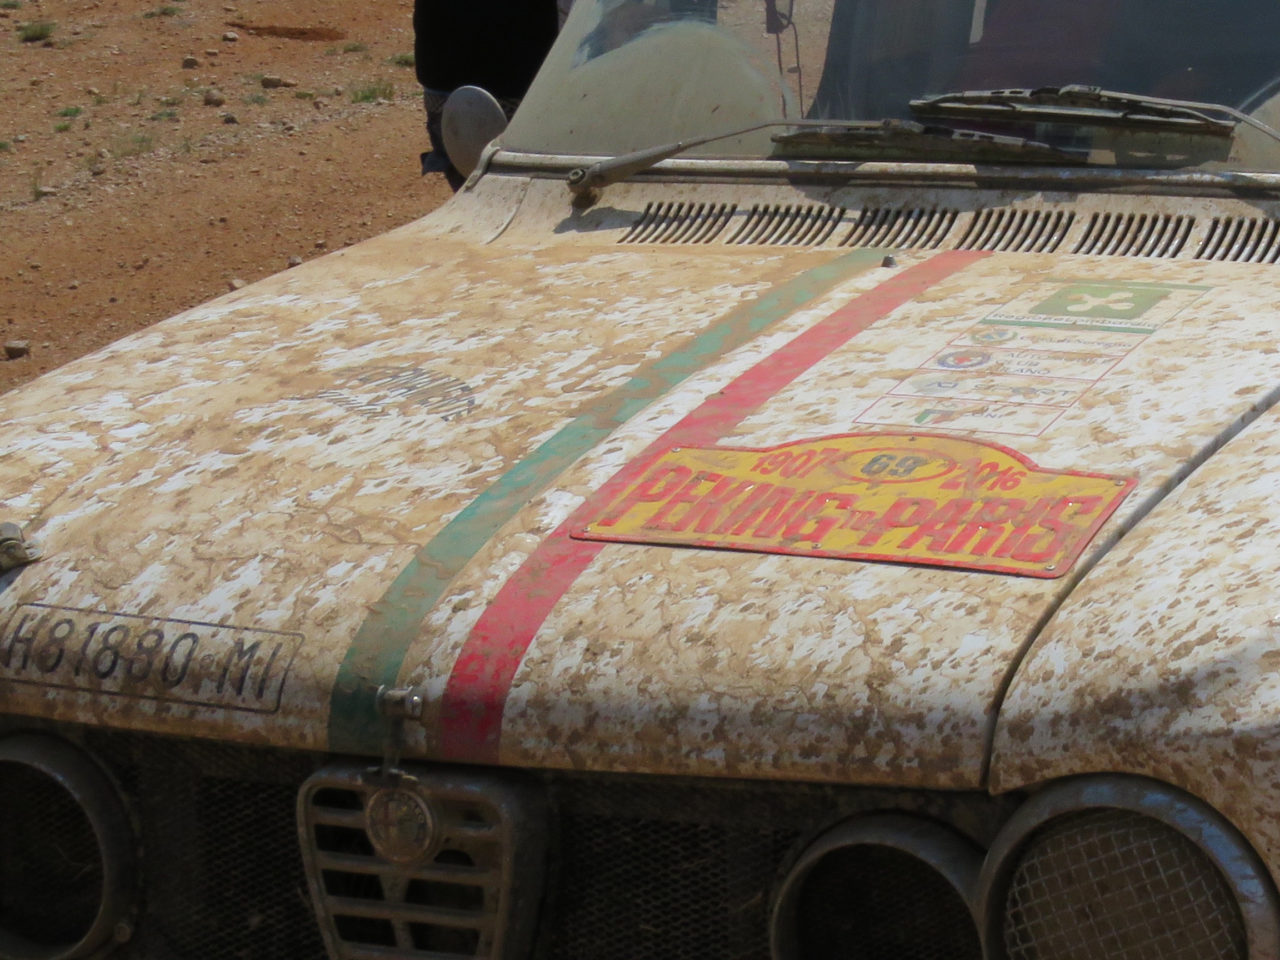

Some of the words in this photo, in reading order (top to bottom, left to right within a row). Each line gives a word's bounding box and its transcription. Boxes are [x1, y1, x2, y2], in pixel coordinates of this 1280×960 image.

[597, 461, 860, 542] PEKING
[857, 495, 1104, 563] PARIS
[215, 637, 284, 700] MI
